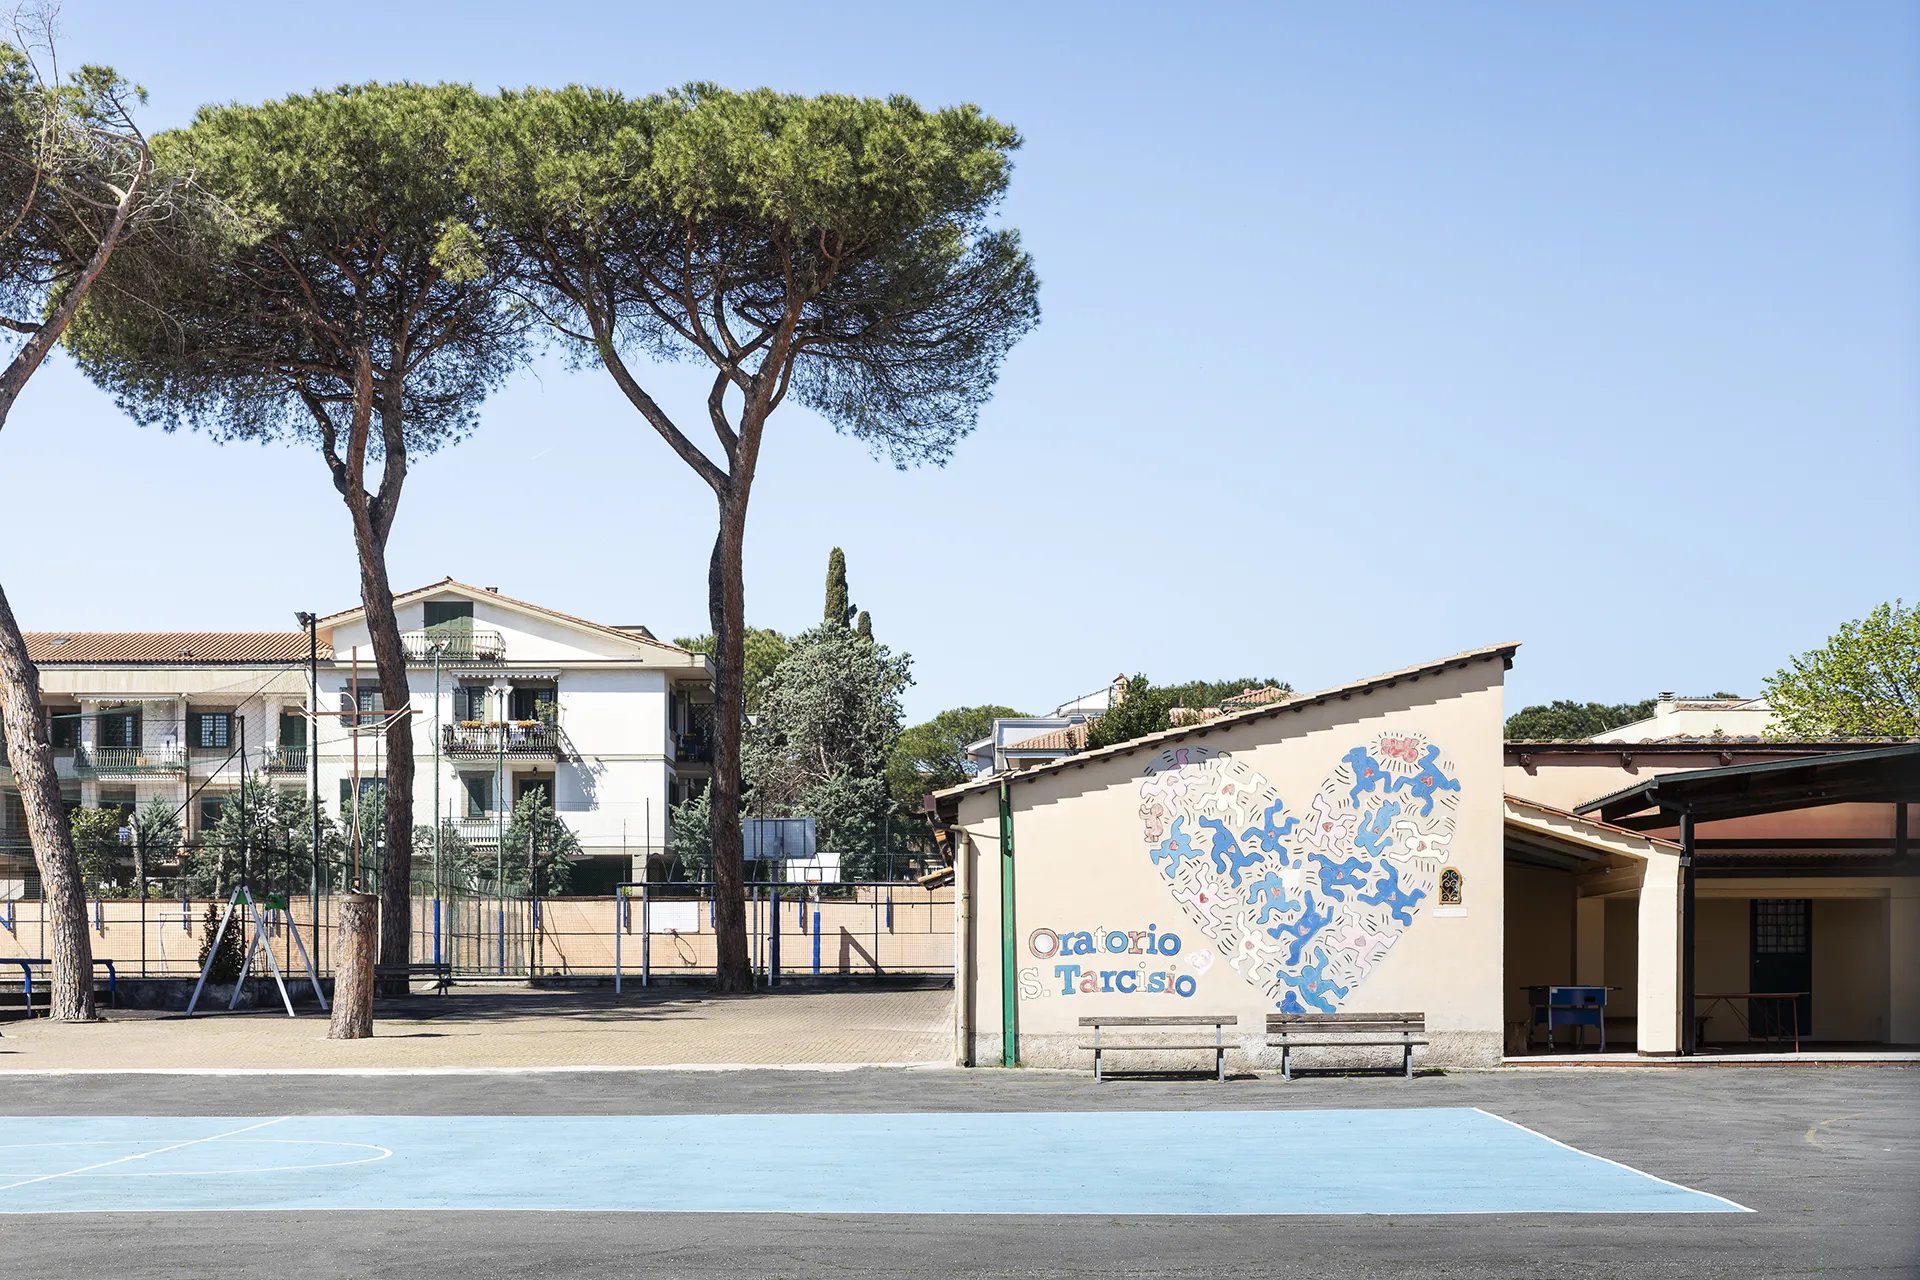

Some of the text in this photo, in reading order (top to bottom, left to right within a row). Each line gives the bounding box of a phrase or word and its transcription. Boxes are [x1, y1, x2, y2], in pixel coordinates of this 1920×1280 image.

[1029, 923, 1181, 959] Oratorio
[1019, 961, 1196, 1000] S. Tarcisio
